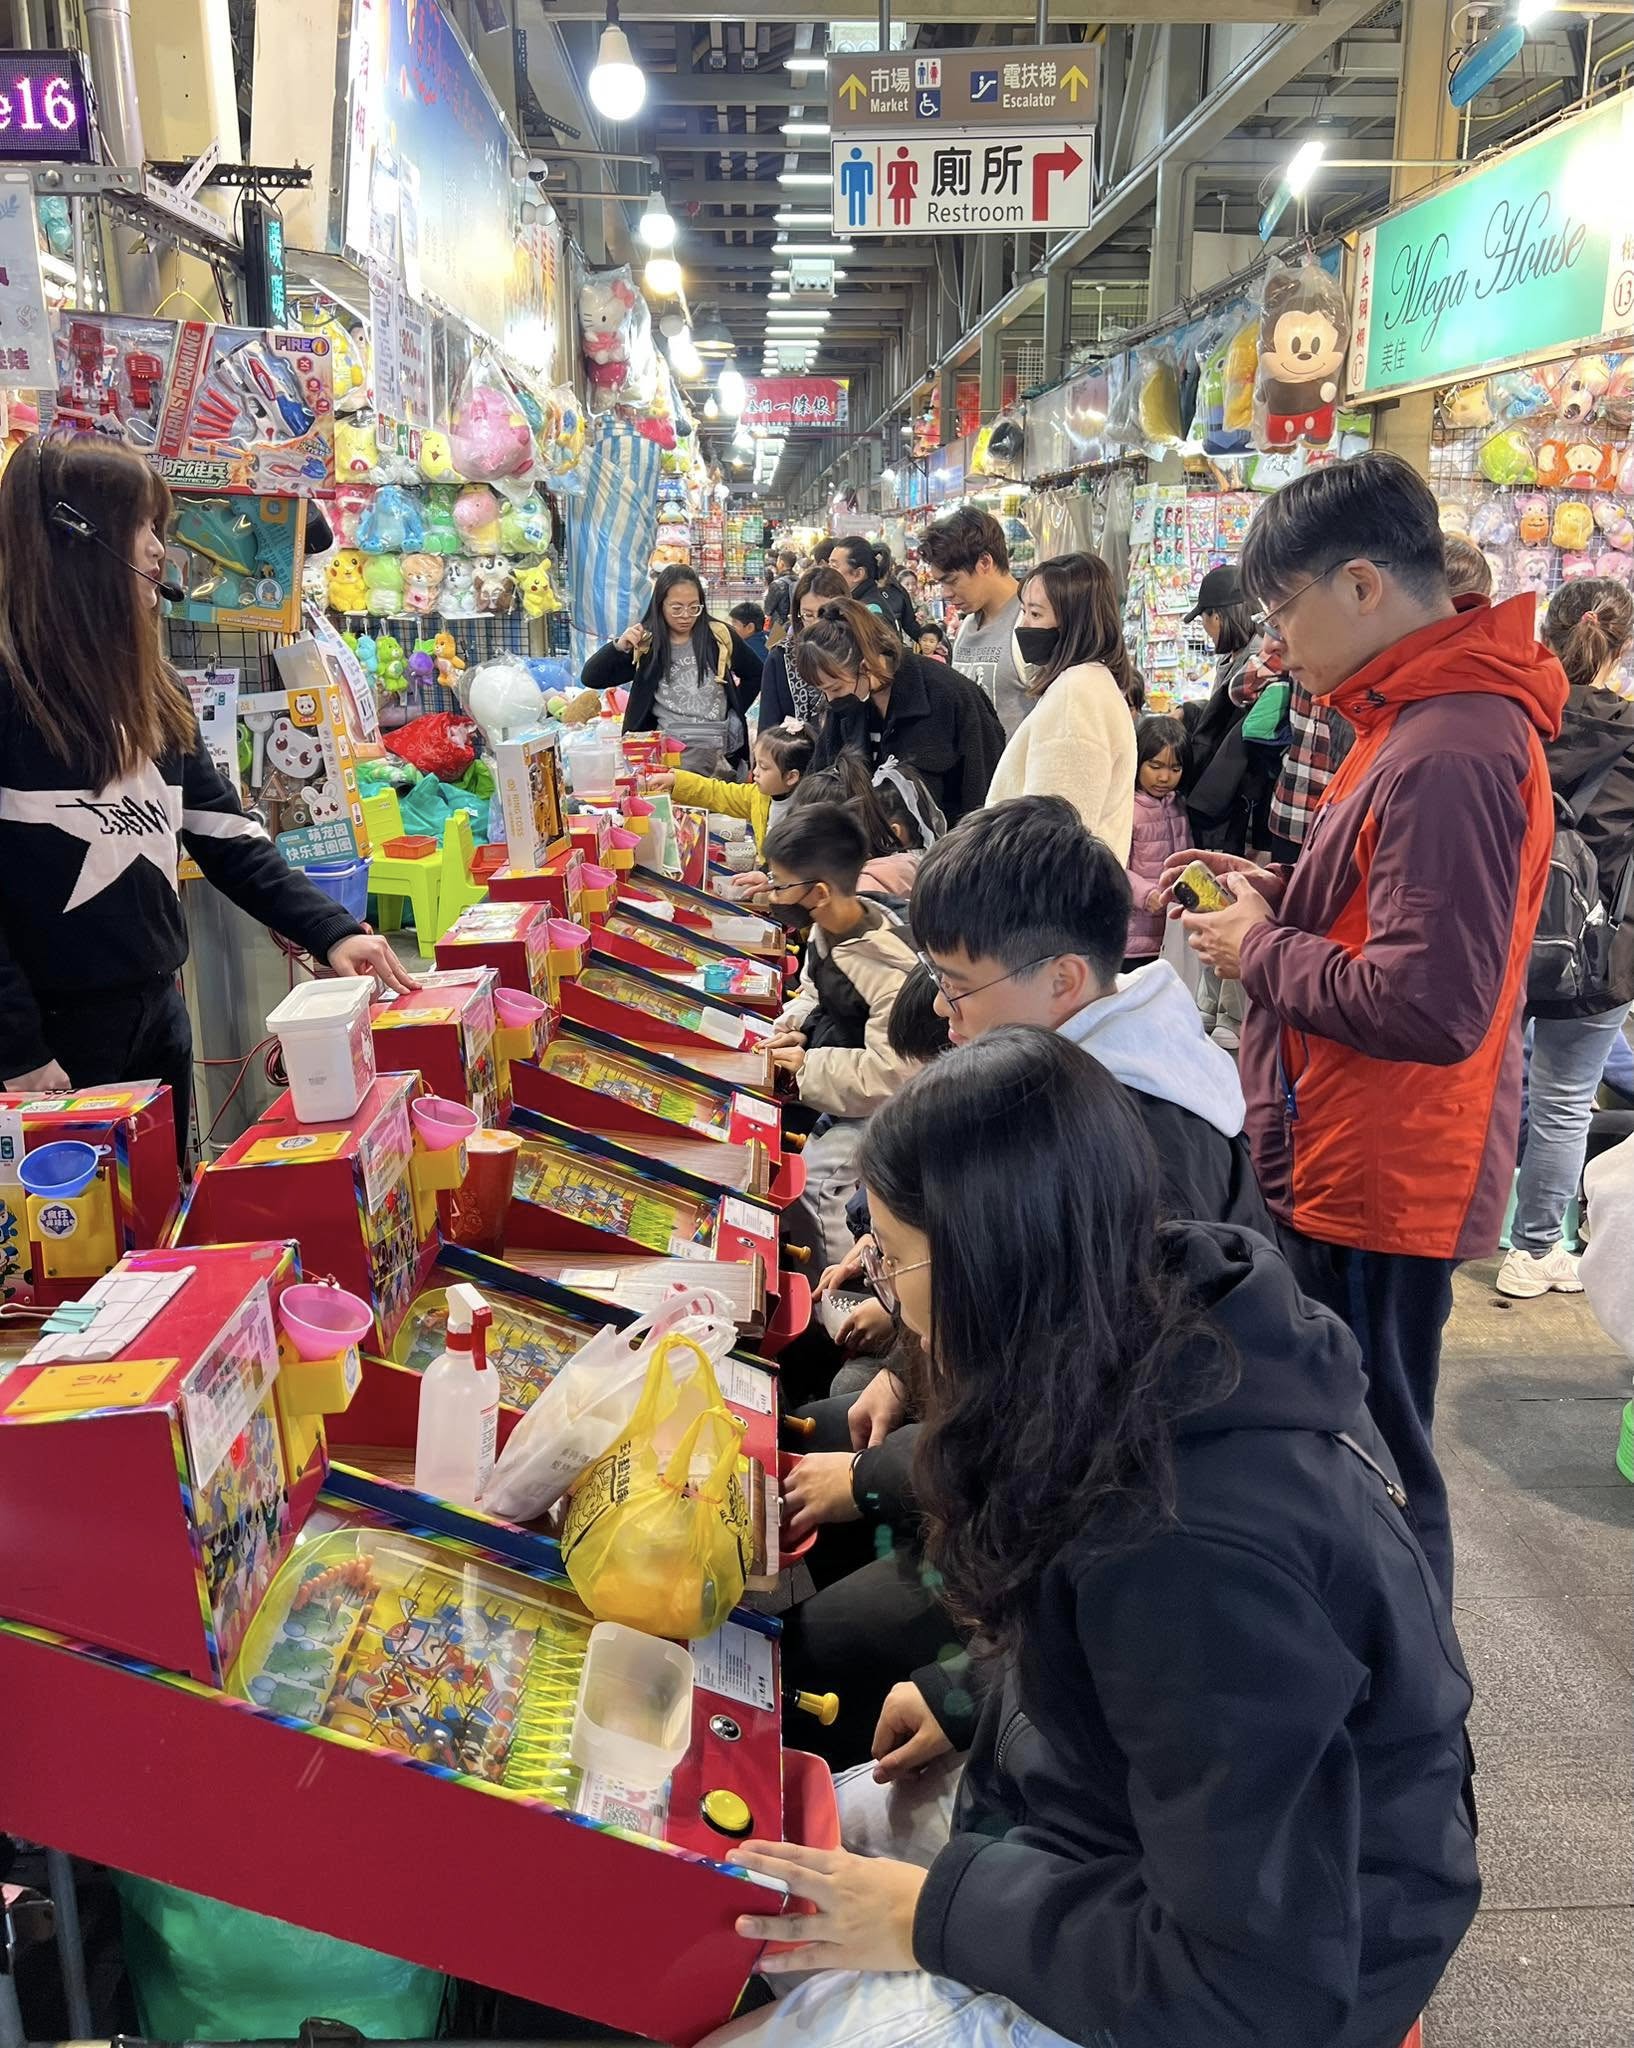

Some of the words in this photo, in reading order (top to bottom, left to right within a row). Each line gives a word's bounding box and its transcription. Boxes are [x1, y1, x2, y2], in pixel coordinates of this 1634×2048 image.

[870, 66, 911, 94] 市場
[1003, 61, 1057, 89] 電扶梯
[870, 98, 909, 113] Market
[1003, 93, 1056, 108] Escalator
[931, 145, 1023, 197] 廁所
[928, 202, 1024, 223] Restroom
[1384, 232, 1469, 353] Mega
[1475, 190, 1587, 300] House
[275, 335, 312, 351] FIRE
[162, 329, 201, 447] TRANSFORMING
[306, 822, 349, 842] 萌宠园
[286, 836, 353, 861] 快乐套圈圈
